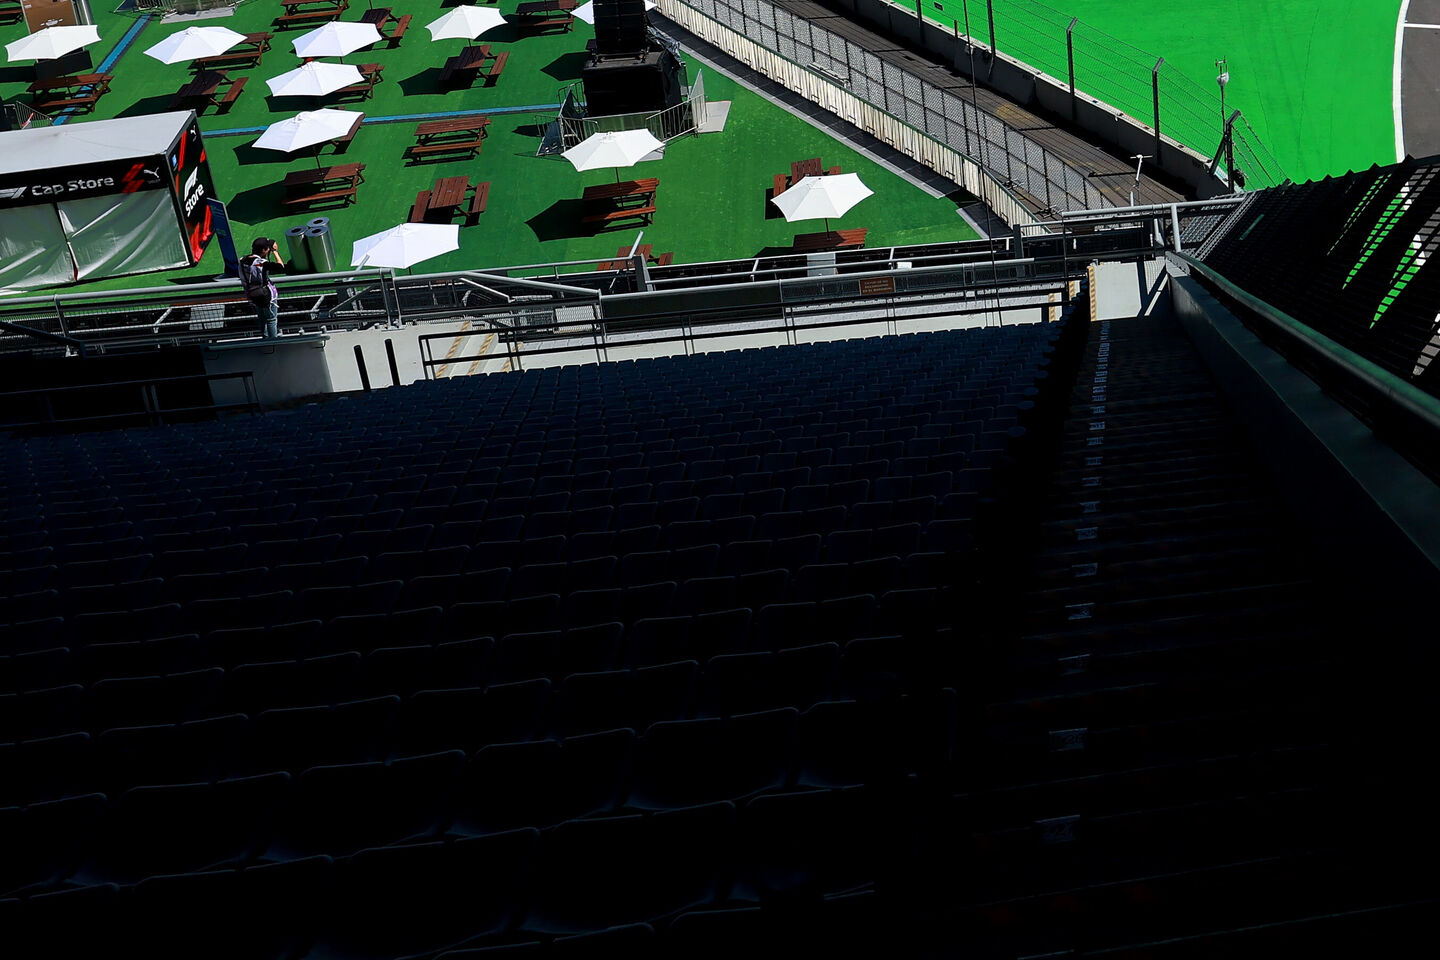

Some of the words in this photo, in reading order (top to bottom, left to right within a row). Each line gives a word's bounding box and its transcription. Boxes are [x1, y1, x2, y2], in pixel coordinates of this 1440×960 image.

[31, 184, 64, 197] Cap
[66, 176, 115, 192] Store
[184, 184, 205, 218] Store
